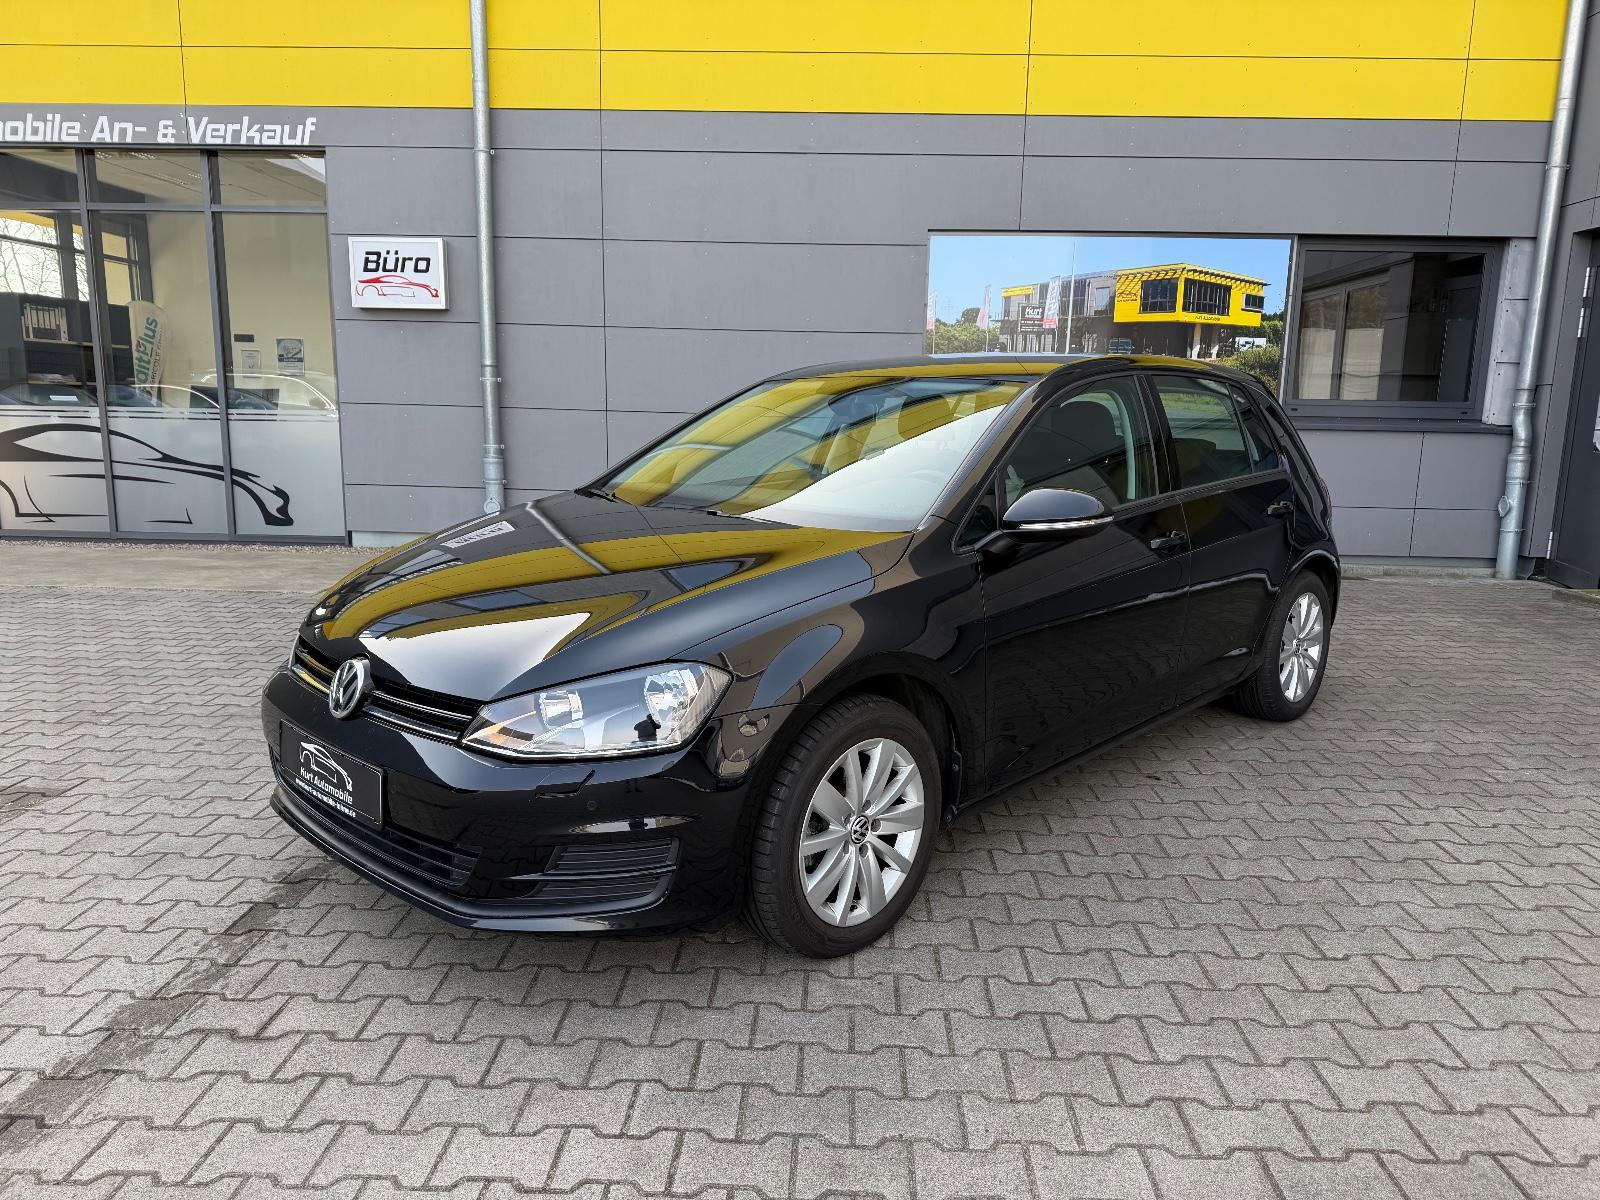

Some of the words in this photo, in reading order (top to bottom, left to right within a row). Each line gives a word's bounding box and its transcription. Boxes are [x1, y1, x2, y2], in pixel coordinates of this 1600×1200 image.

[0, 112, 81, 142] obile
[90, 115, 147, 142] An-
[156, 119, 176, 143] &
[187, 116, 317, 145] Verkauf
[362, 249, 431, 273] Büro
[135, 316, 158, 386] ditPlus
[300, 766, 314, 783] Kurt
[313, 775, 353, 805] Automobile
